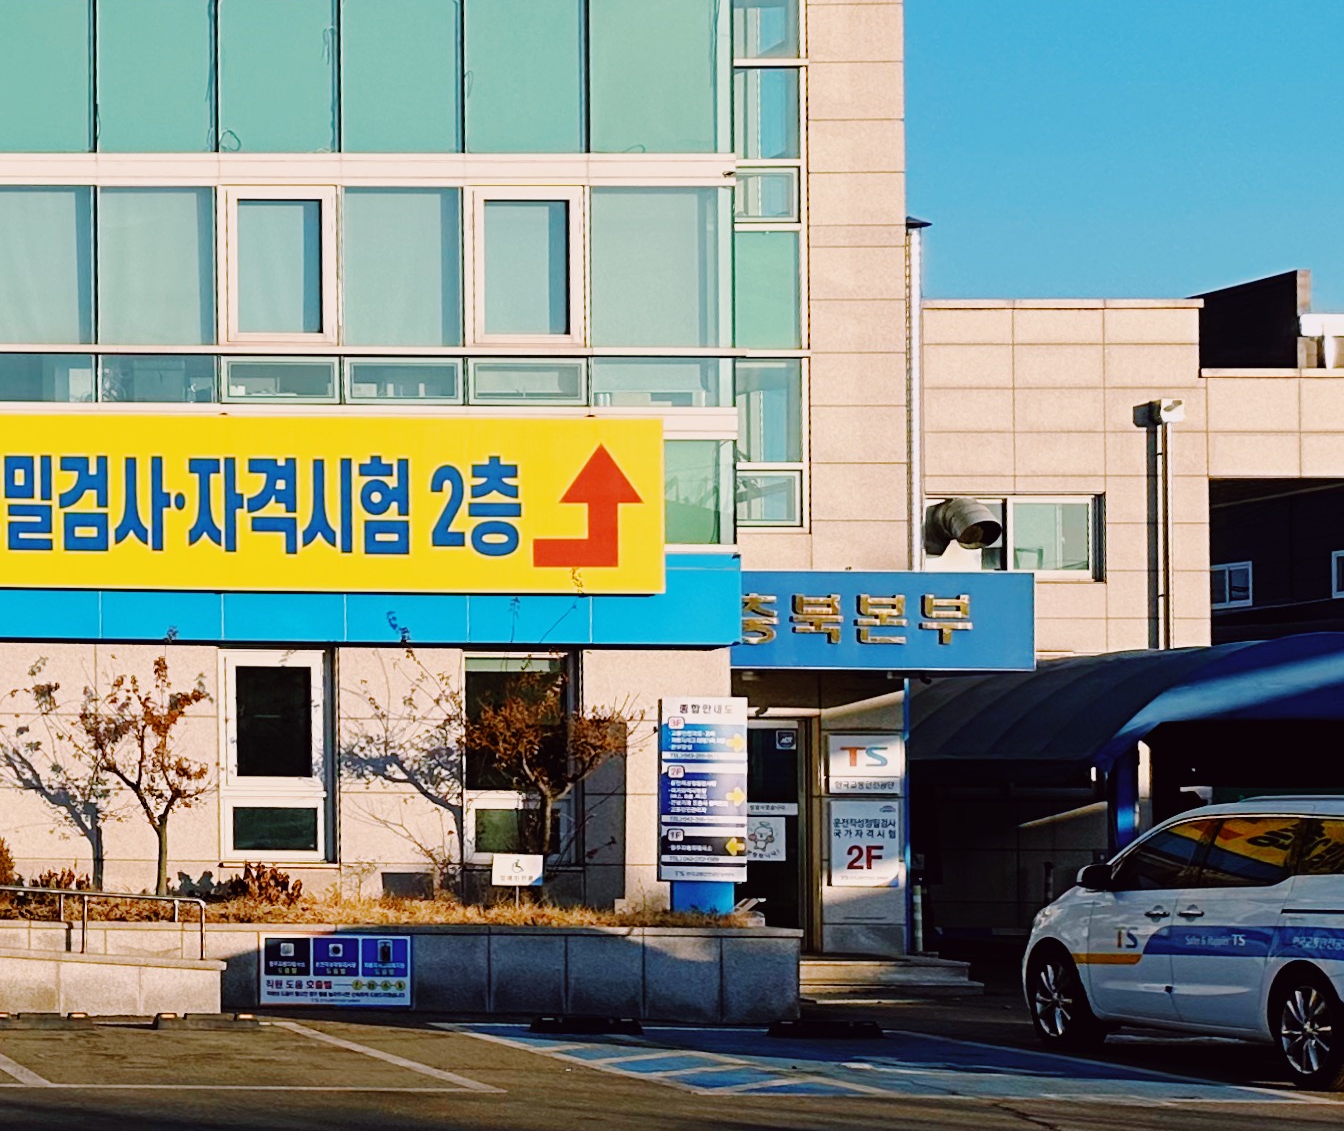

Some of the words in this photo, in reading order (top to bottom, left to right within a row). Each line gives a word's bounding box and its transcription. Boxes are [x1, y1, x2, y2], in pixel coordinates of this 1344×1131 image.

[429, 454, 523, 556] 2층
[840, 746, 888, 767] TS
[833, 817, 896, 829] 운전적성정밀검사
[833, 828, 897, 840] 국가자격시험
[846, 845, 884, 870] 2F
[1114, 926, 1139, 949] TS
[1231, 933, 1246, 946] TS
